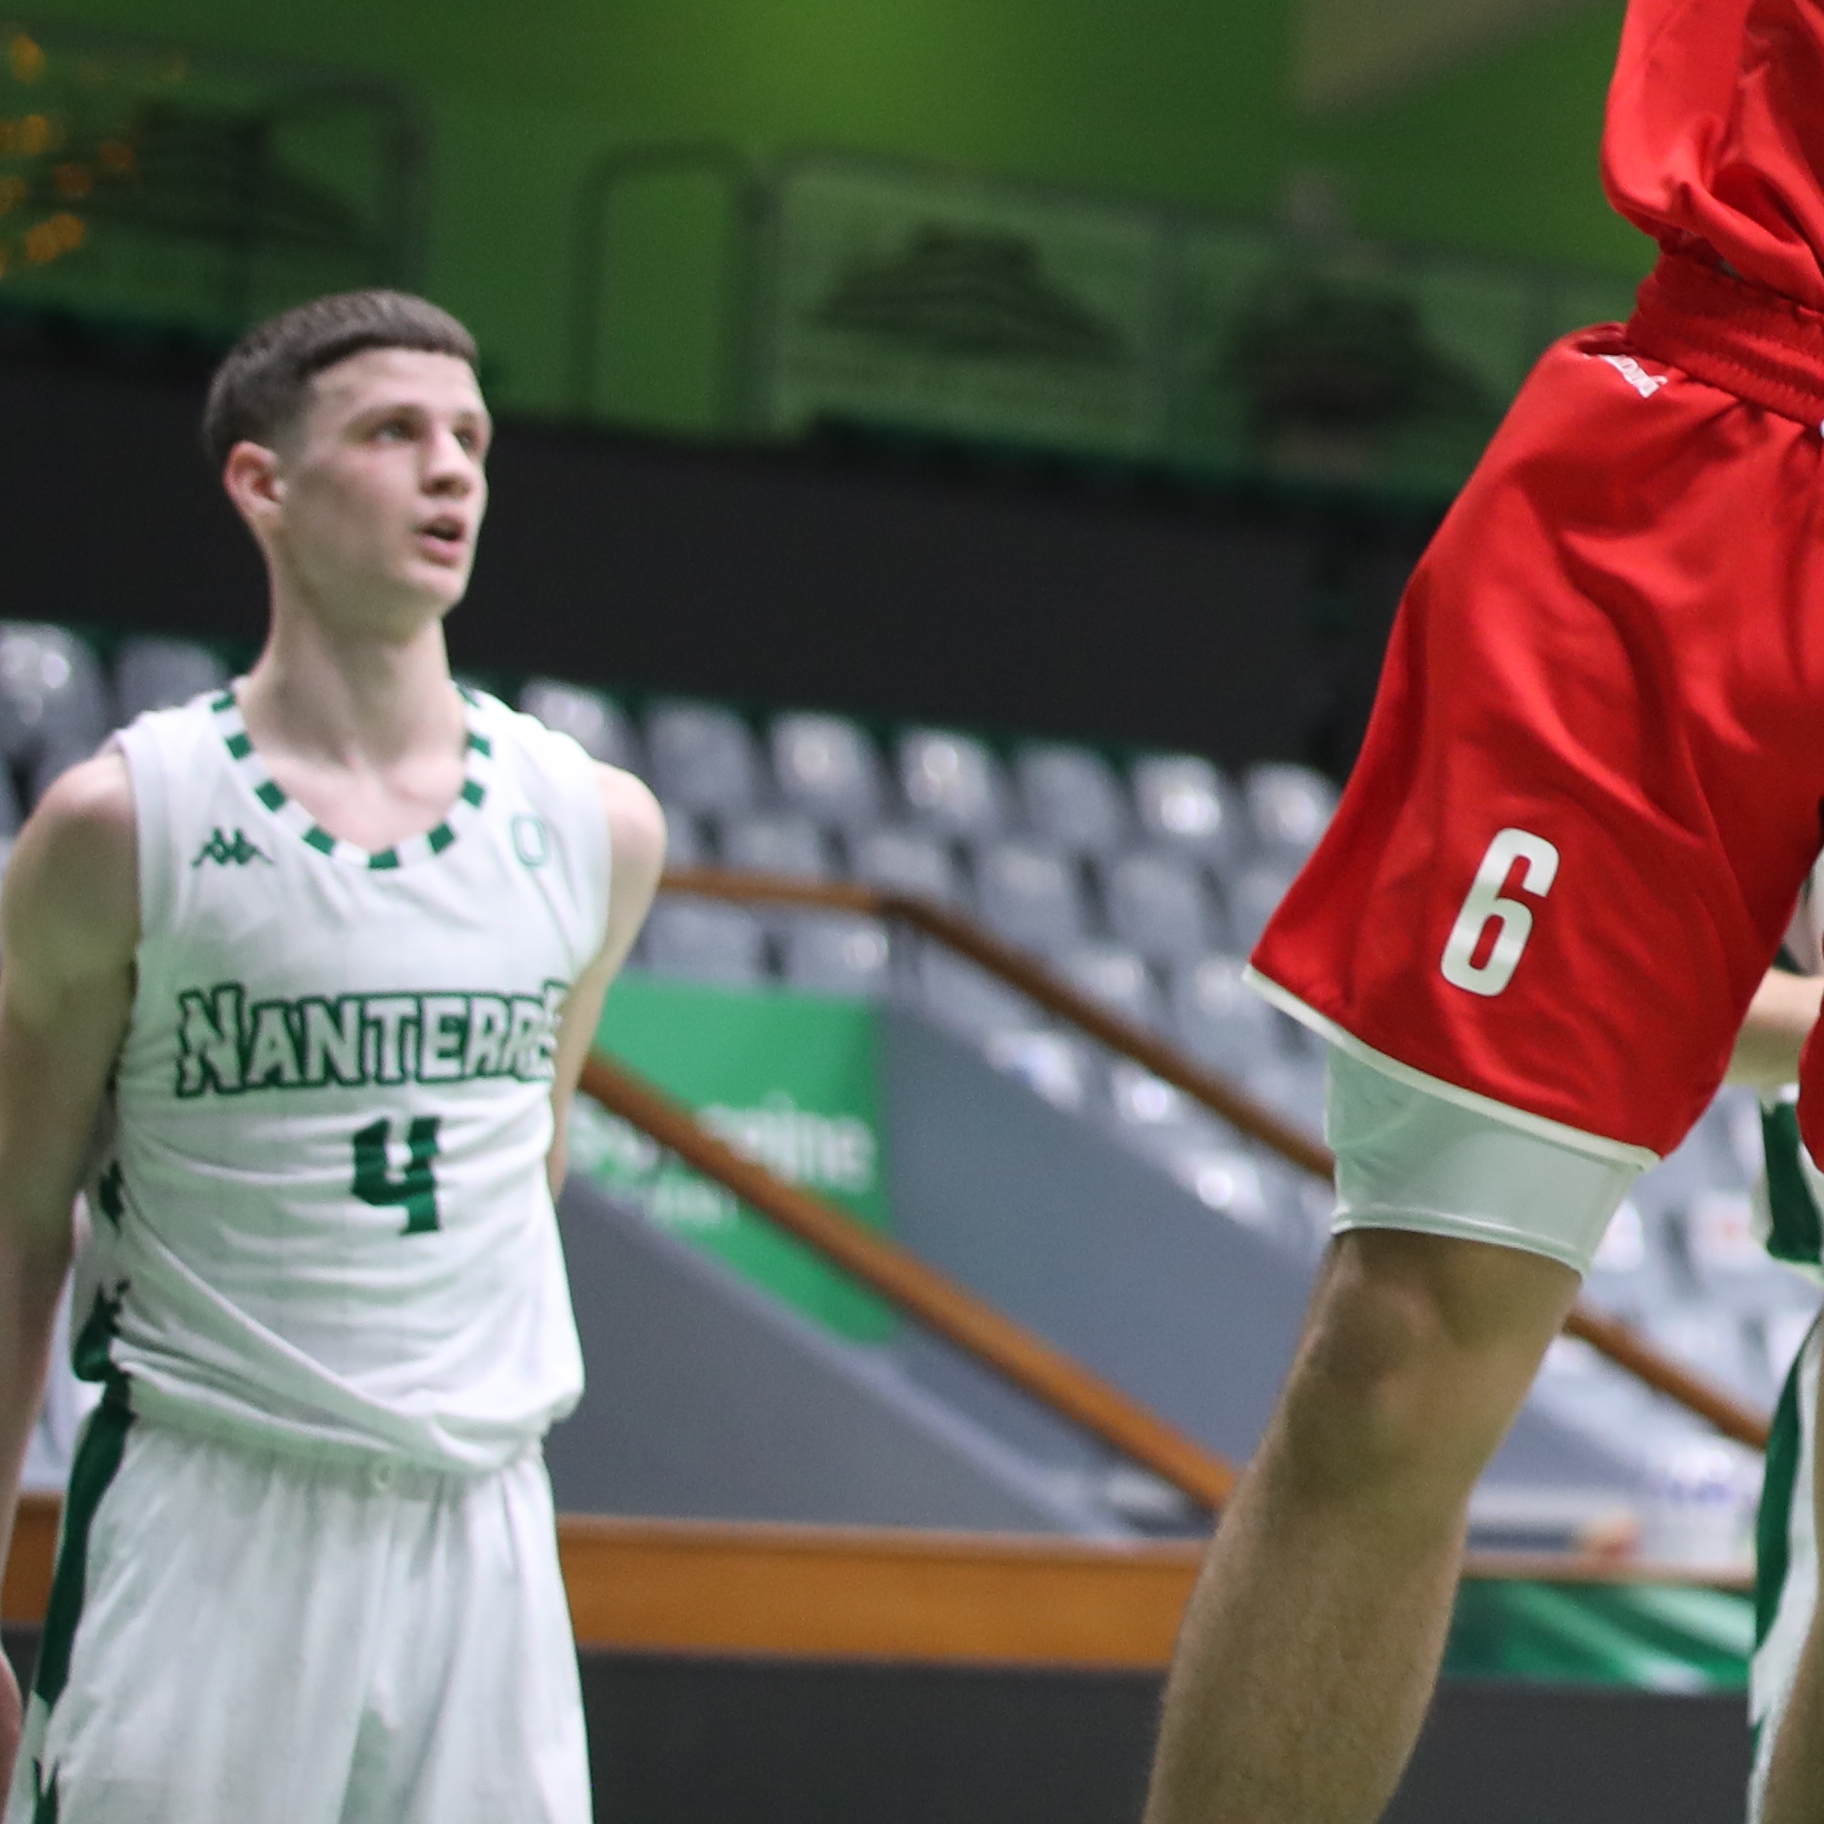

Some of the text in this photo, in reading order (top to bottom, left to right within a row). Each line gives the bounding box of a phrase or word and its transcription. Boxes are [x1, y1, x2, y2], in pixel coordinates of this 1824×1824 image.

[1440, 827, 1561, 997] 6
[175, 978, 571, 1100] NANTERRE
[351, 1115, 442, 1235] 4
